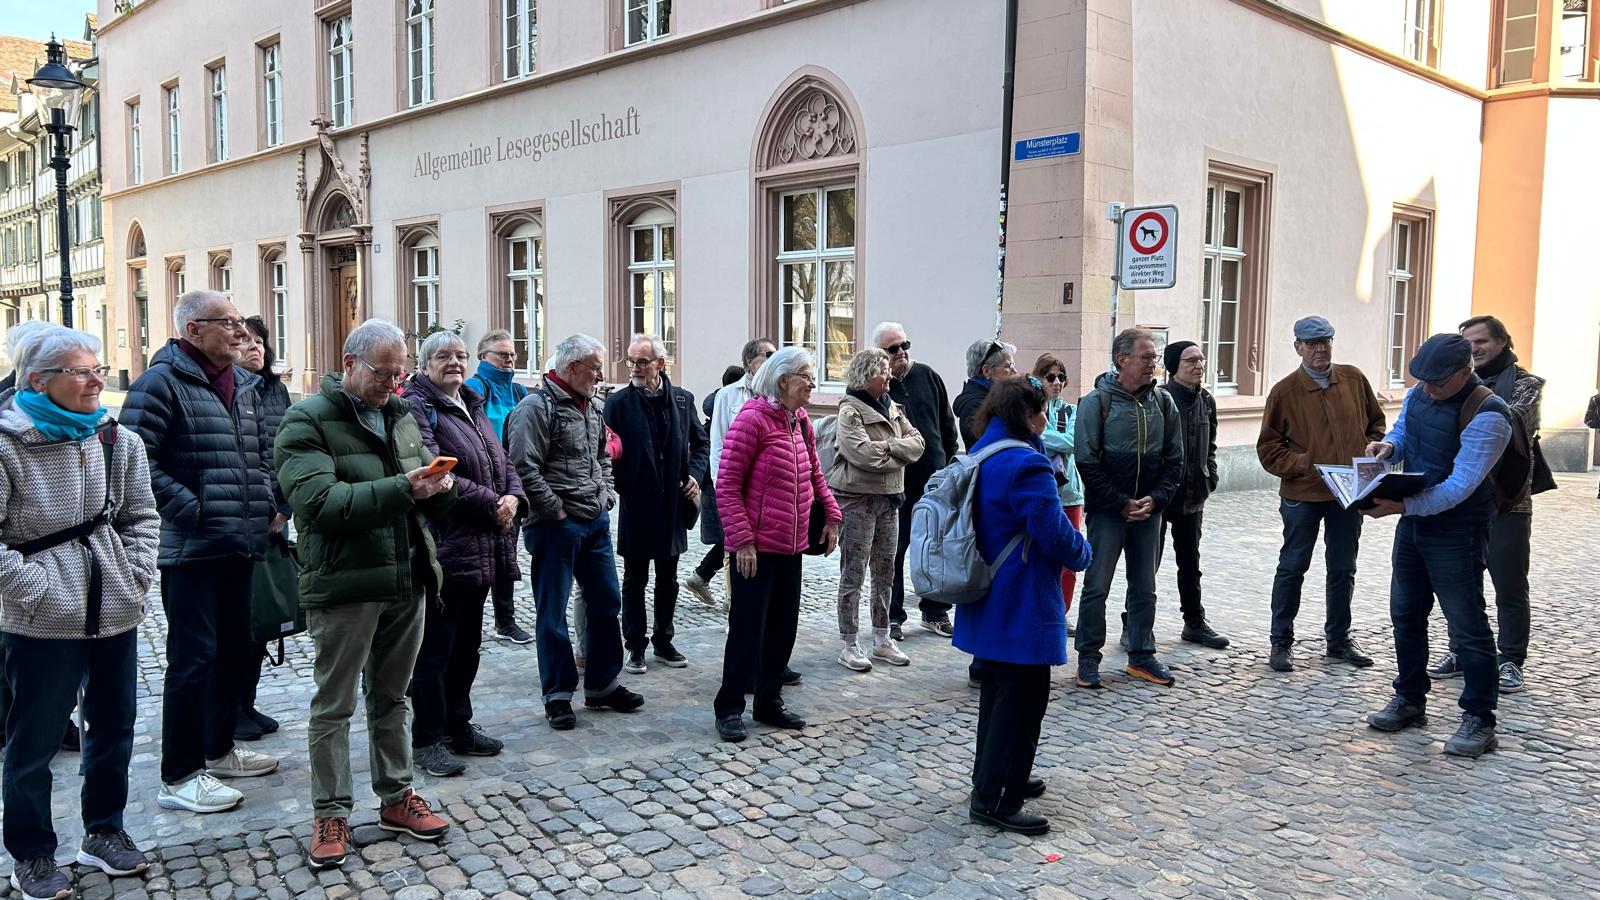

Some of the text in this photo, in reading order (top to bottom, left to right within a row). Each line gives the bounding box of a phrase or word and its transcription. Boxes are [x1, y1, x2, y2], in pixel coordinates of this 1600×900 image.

[413, 106, 641, 181] Allgemeine Lesegesellschaft
[1026, 136, 1068, 148] Münsterplatz
